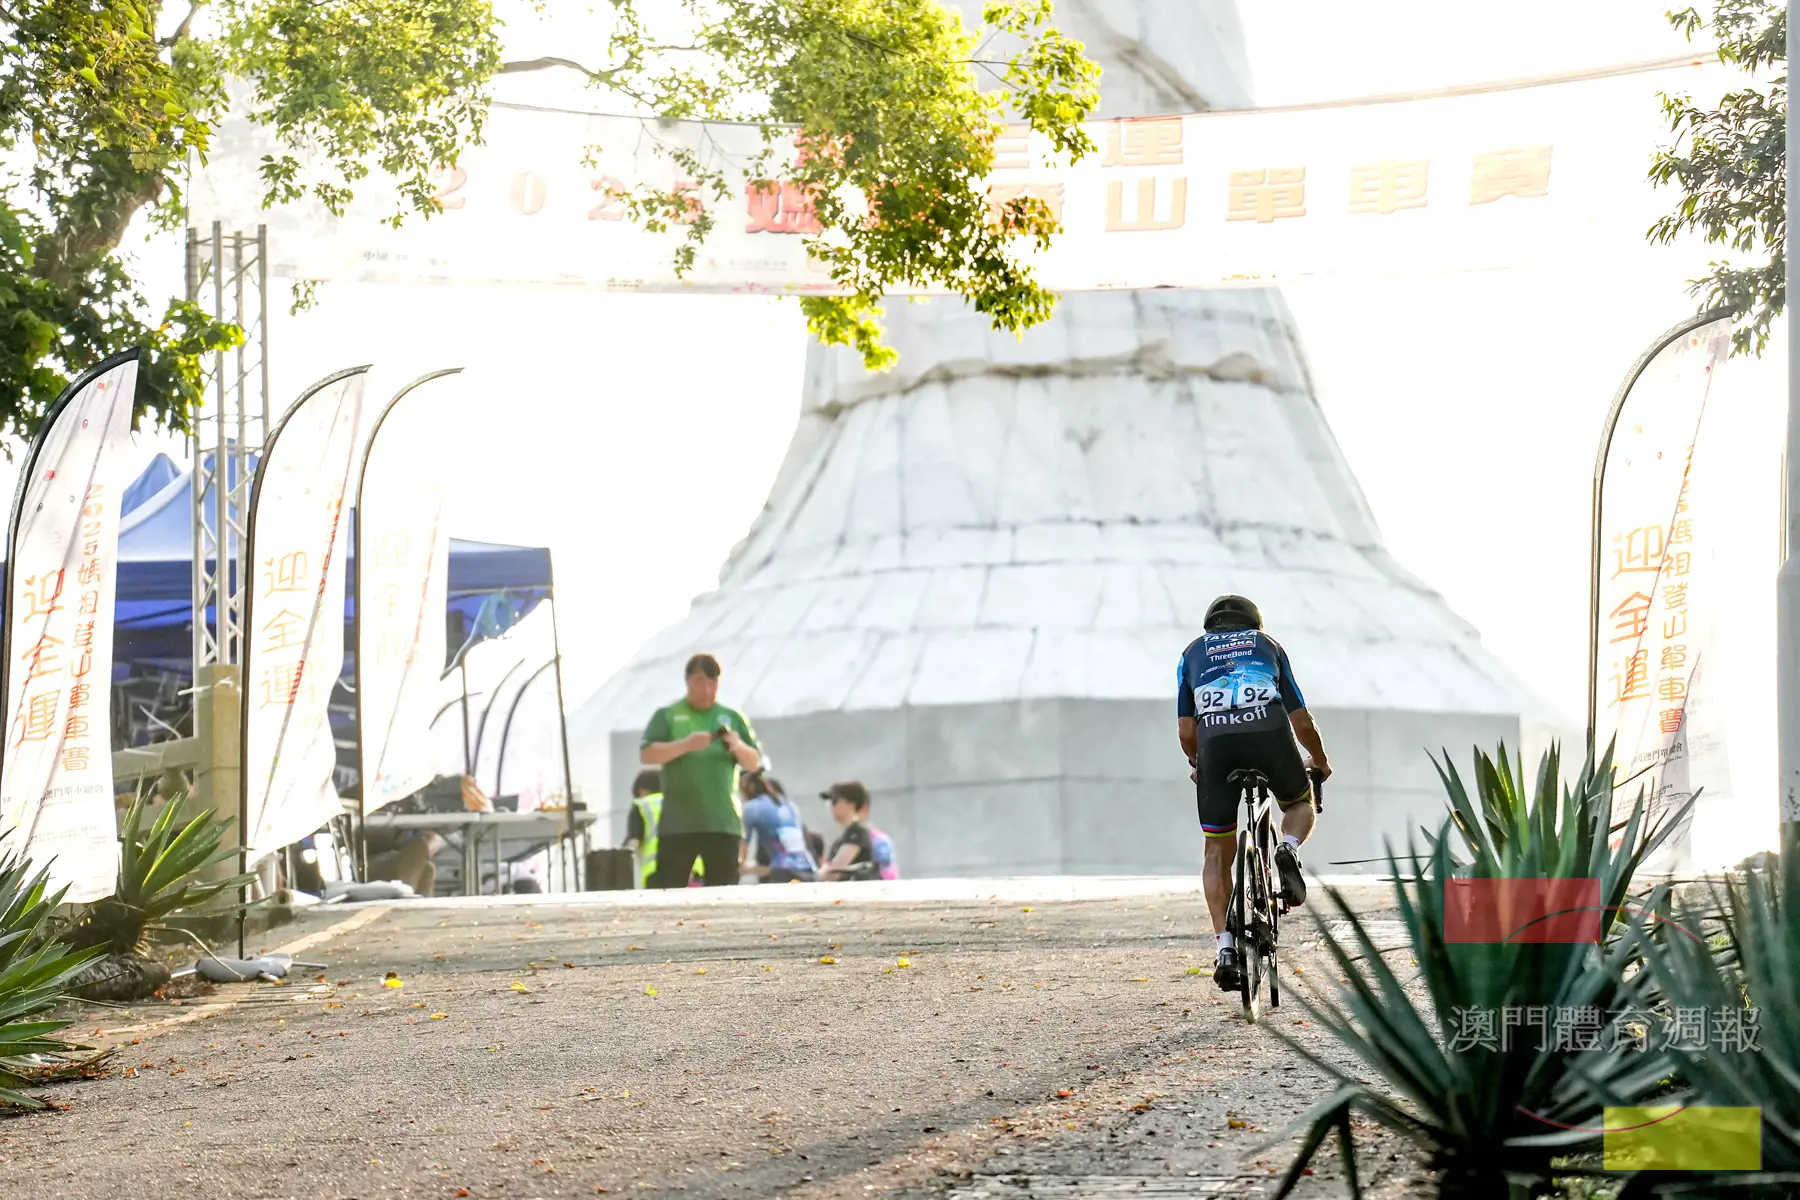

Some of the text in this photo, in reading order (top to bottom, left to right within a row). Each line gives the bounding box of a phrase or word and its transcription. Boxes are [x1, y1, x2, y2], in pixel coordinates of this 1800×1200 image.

[1606, 525, 1663, 709] 迎全運
[258, 550, 309, 710] 迎全運
[14, 565, 66, 749] 迎全運
[1210, 649, 1252, 662] ThreeBond
[1202, 691, 1224, 708] 92
[1244, 687, 1270, 703] 92
[1202, 706, 1267, 728] Tinkoff
